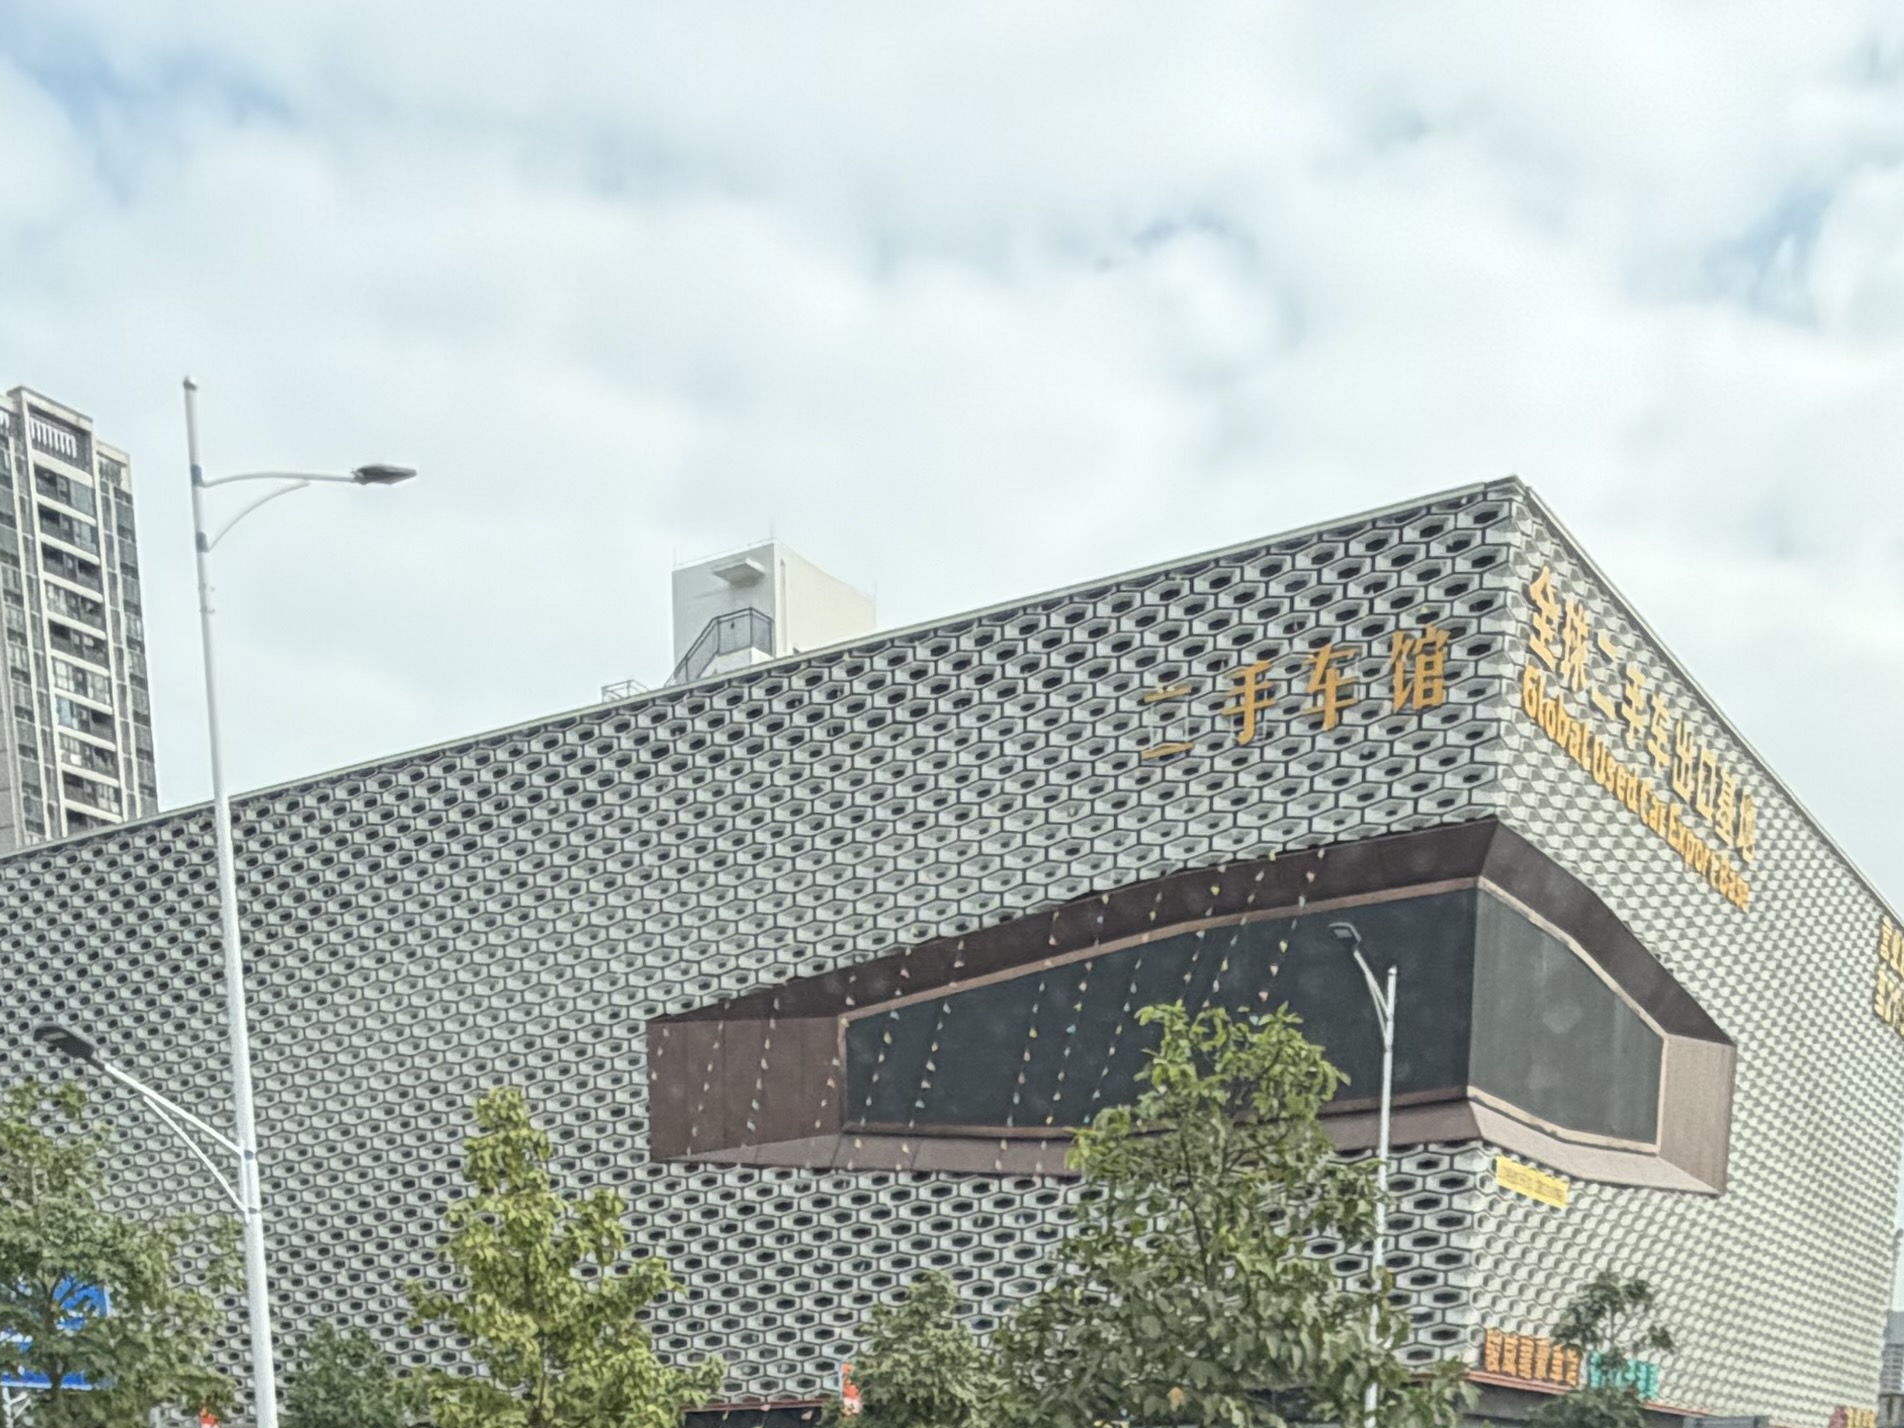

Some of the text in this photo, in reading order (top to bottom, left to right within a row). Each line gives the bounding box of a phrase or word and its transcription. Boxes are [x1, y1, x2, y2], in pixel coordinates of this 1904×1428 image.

[1140, 623, 1450, 761] 二手车馆
[1523, 665, 1592, 773] Global
[1593, 739, 1639, 813] Used
[1640, 777, 1667, 841] Car
[1528, 566, 1758, 864] 全球二手车出口基地
